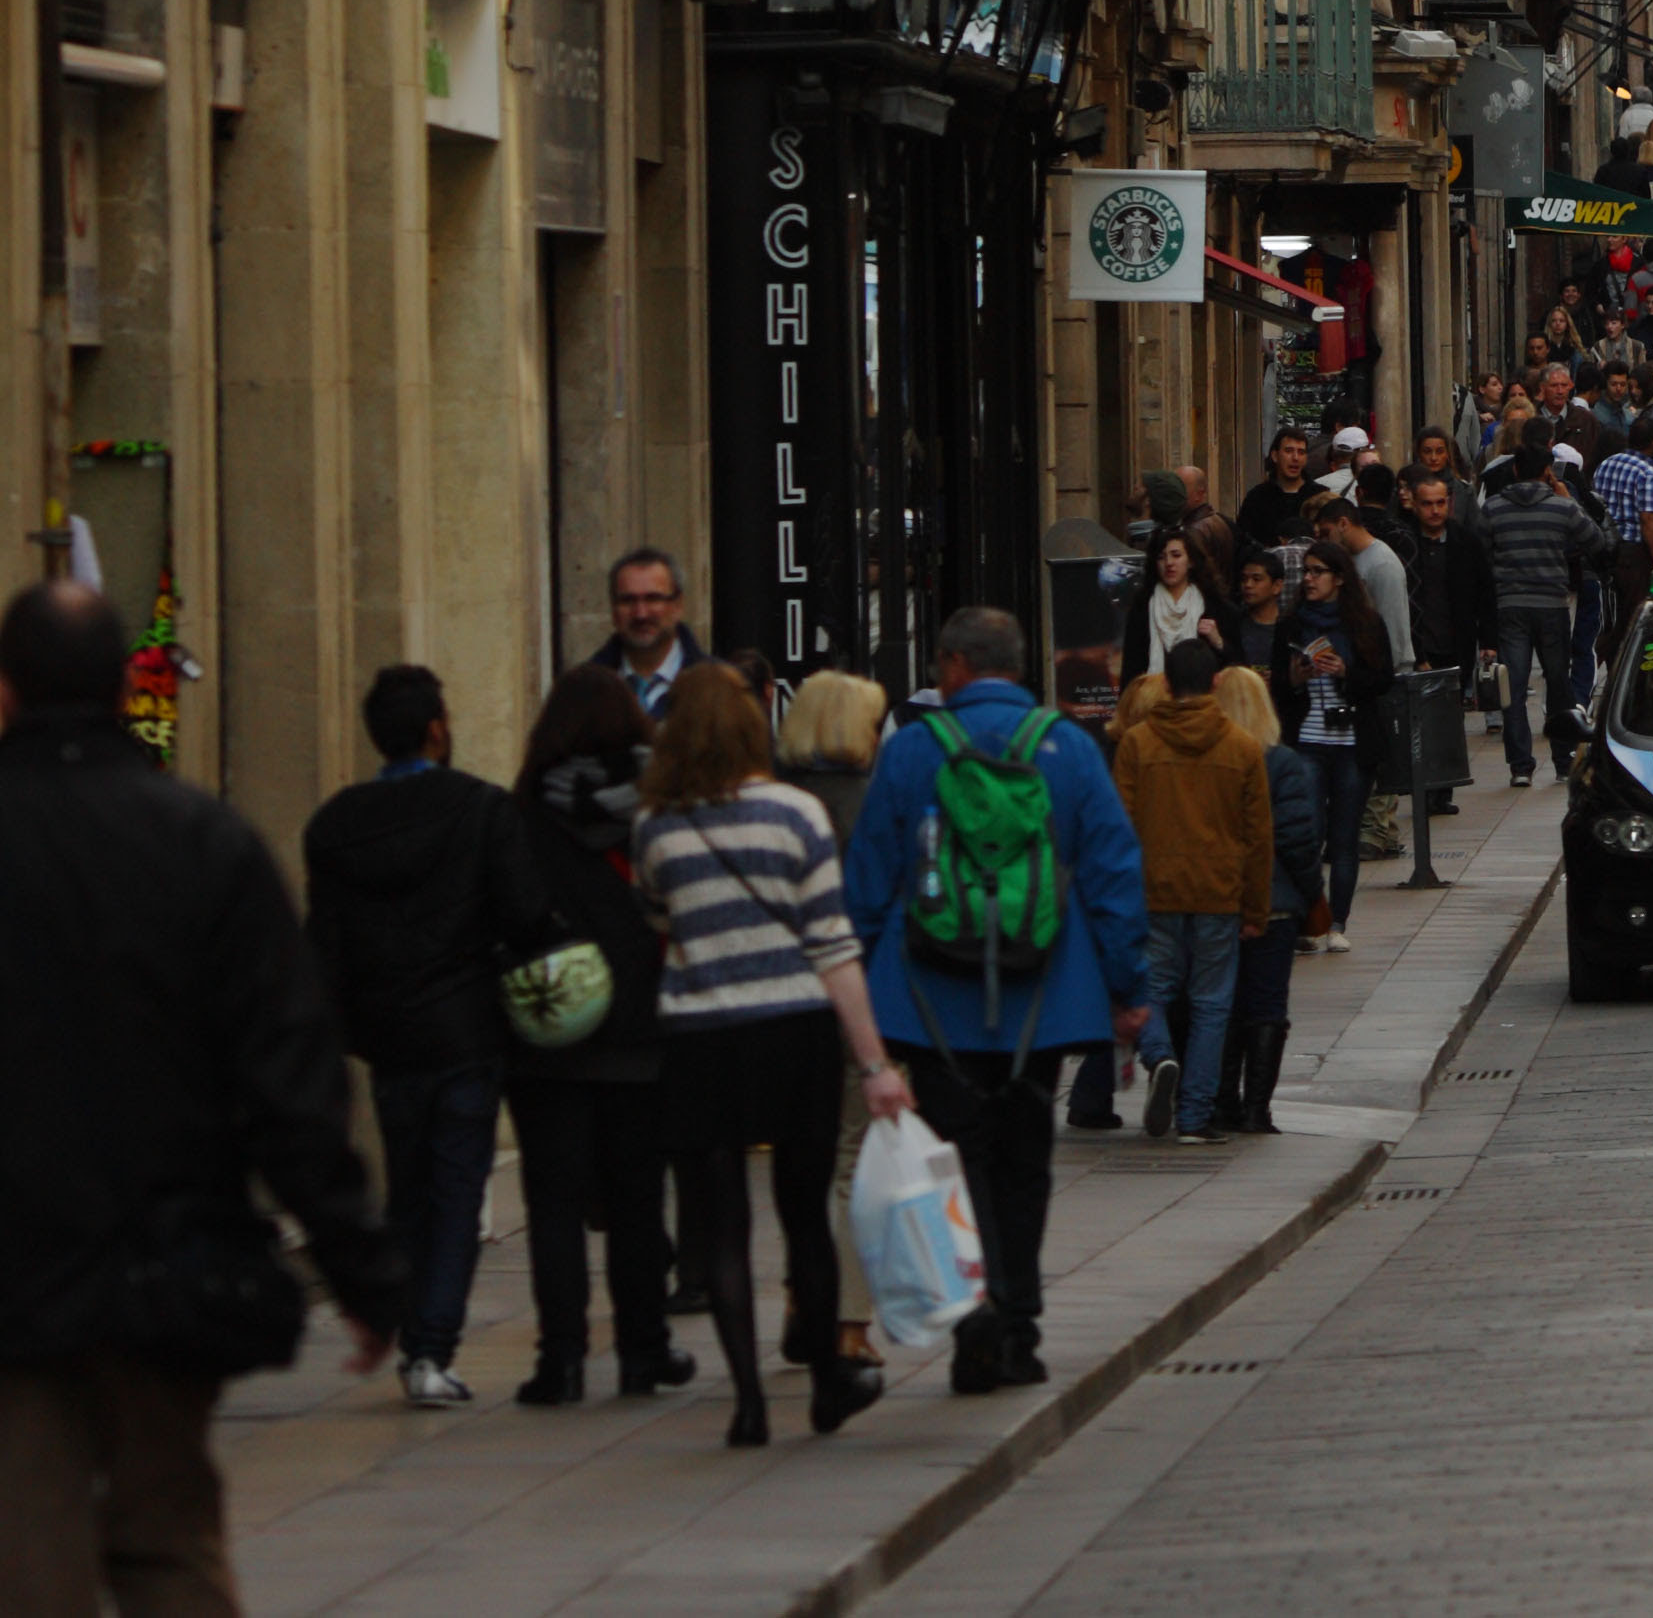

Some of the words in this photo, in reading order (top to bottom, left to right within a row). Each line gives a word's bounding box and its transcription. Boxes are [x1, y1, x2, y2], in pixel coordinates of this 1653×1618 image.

[1092, 189, 1182, 231] STARBUCKS
[1523, 196, 1638, 226] SUBWAY
[1101, 254, 1170, 281] COFFEE
[763, 126, 809, 739] SCHILLIN
